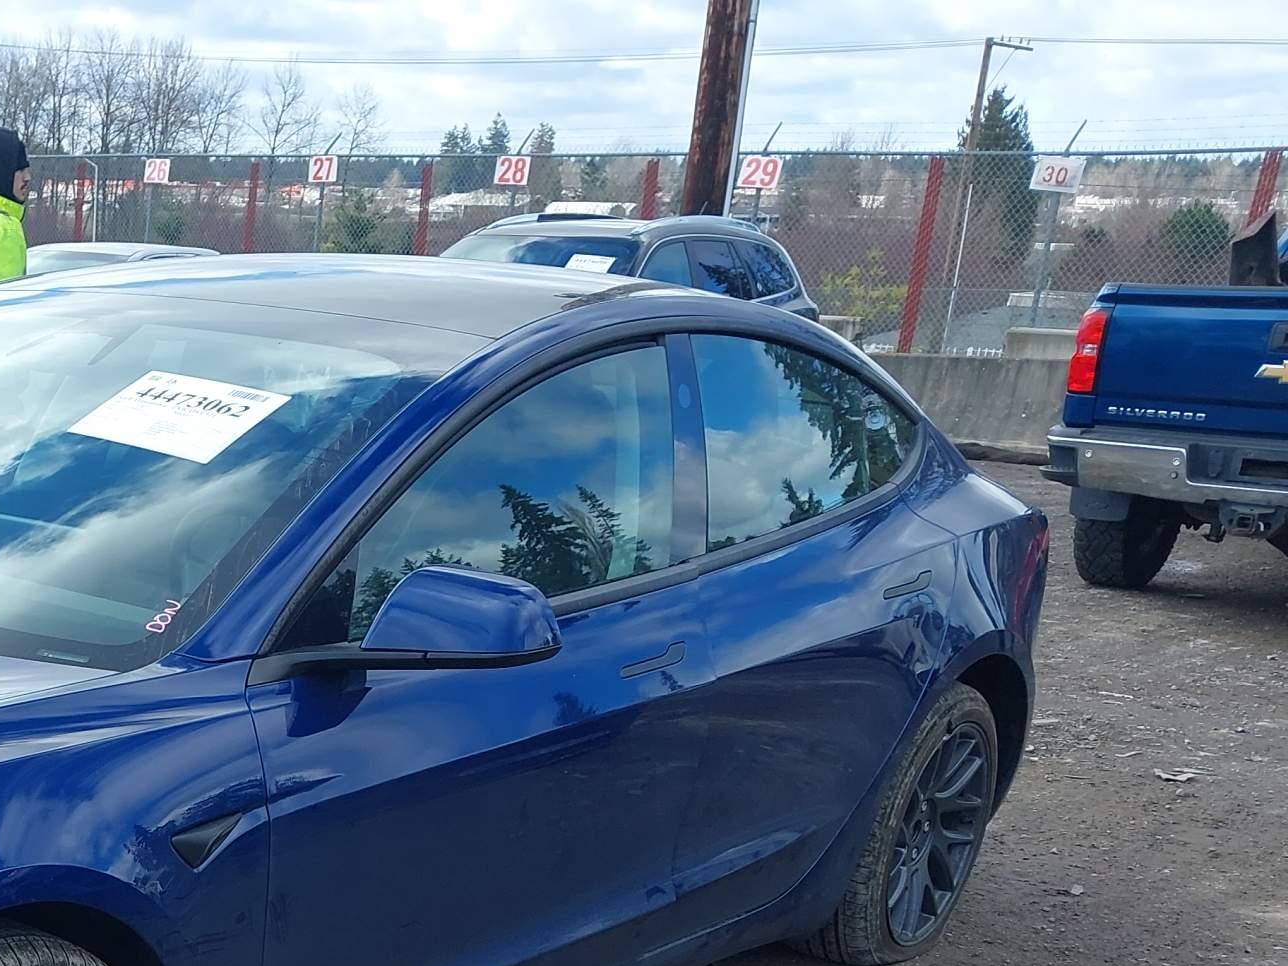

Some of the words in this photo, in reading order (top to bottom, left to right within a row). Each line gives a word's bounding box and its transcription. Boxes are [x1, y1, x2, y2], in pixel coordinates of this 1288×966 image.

[146, 160, 167, 181] 26
[312, 157, 334, 181] 27
[498, 157, 527, 183] 28
[741, 158, 778, 186] 29
[1042, 165, 1068, 185] 30
[136, 386, 251, 418] 44473062
[1107, 406, 1206, 421] SILVERADO
